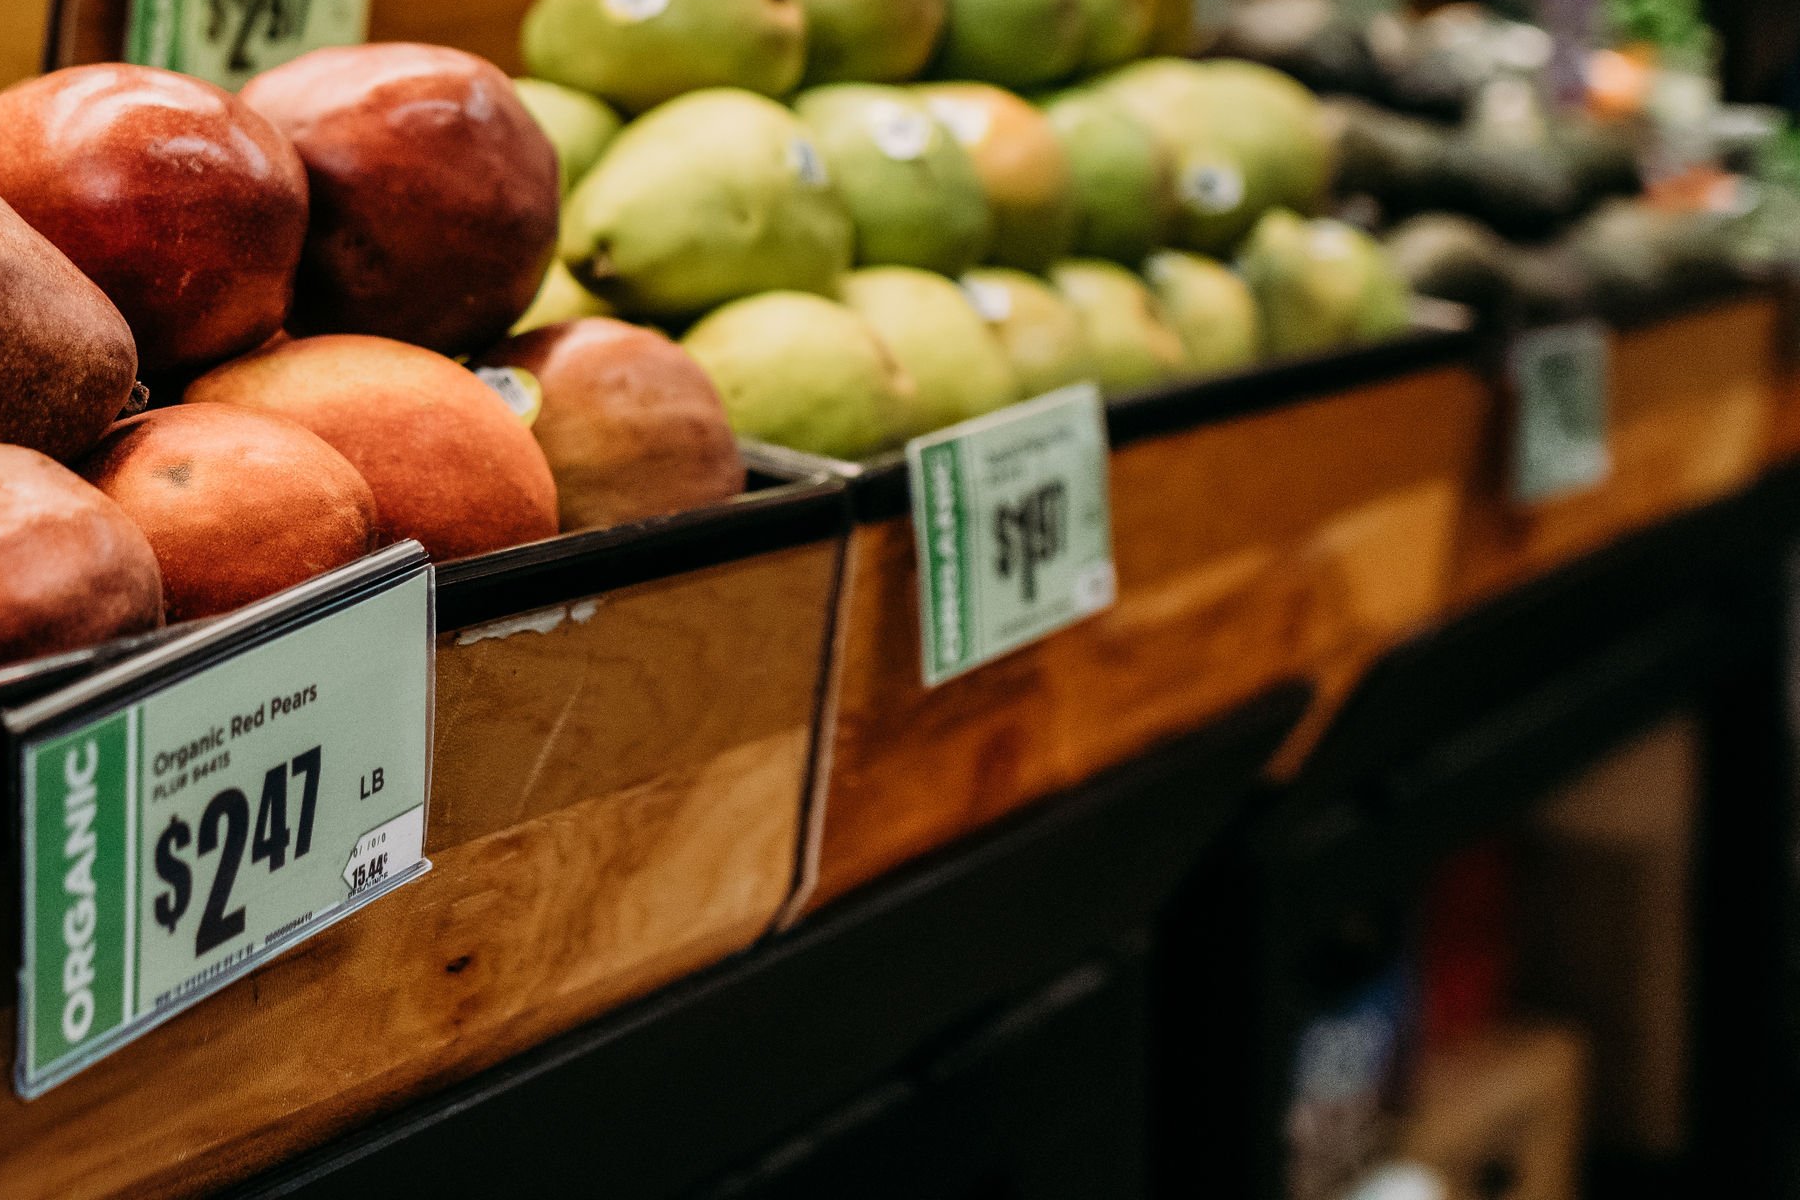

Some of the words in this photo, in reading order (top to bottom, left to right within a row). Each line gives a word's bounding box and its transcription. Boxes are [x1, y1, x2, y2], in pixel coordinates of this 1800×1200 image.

[152, 725, 226, 777] Organic
[230, 703, 265, 739] Red
[270, 682, 318, 720] Pears
[360, 766, 385, 801] LB
[62, 738, 99, 1043] ORGANIC
